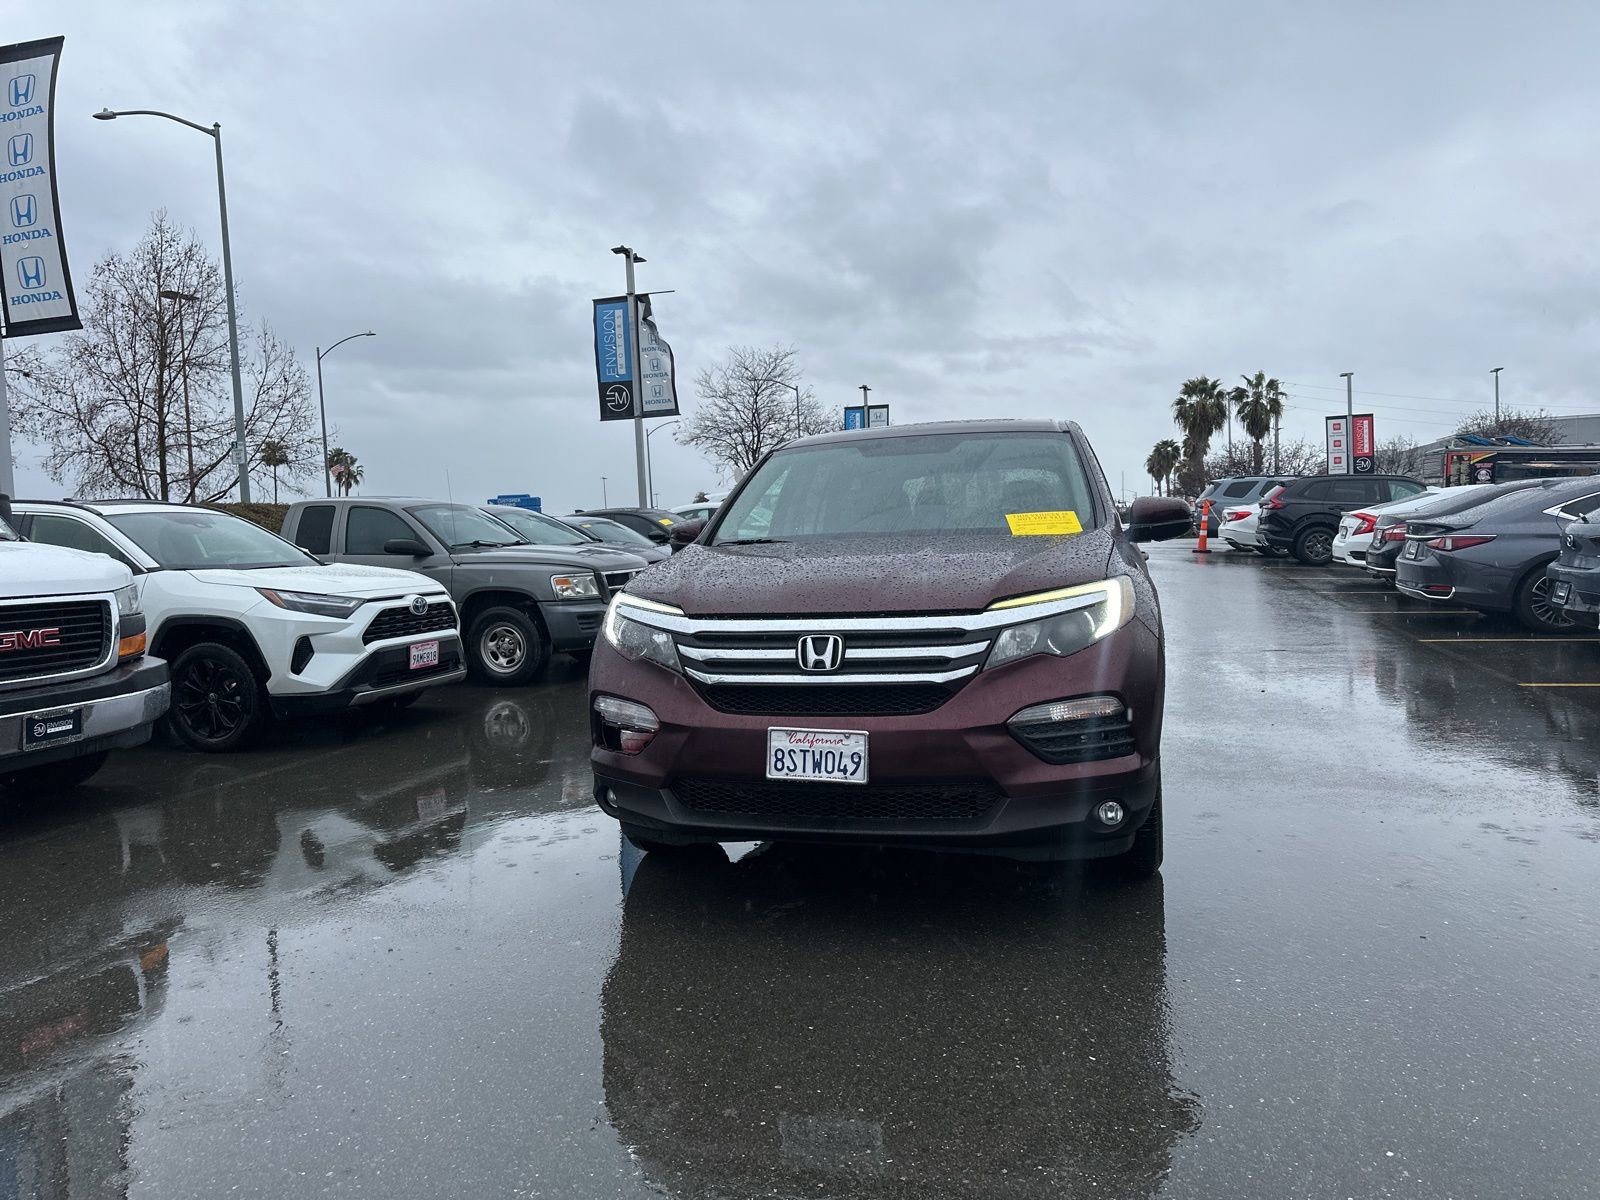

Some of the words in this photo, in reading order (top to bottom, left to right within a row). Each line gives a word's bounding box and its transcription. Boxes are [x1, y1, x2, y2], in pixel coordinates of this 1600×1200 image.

[0, 166, 46, 183] HONDA
[3, 228, 52, 245] HONDA
[11, 290, 63, 306] HONDA
[603, 309, 617, 376] ENVISION
[642, 371, 669, 379] HONDA
[1356, 420, 1364, 454] ENVISION
[0, 628, 60, 651] GMC
[47, 719, 73, 728] ENVISION
[788, 731, 850, 748] California
[773, 748, 862, 776] 8STW049
